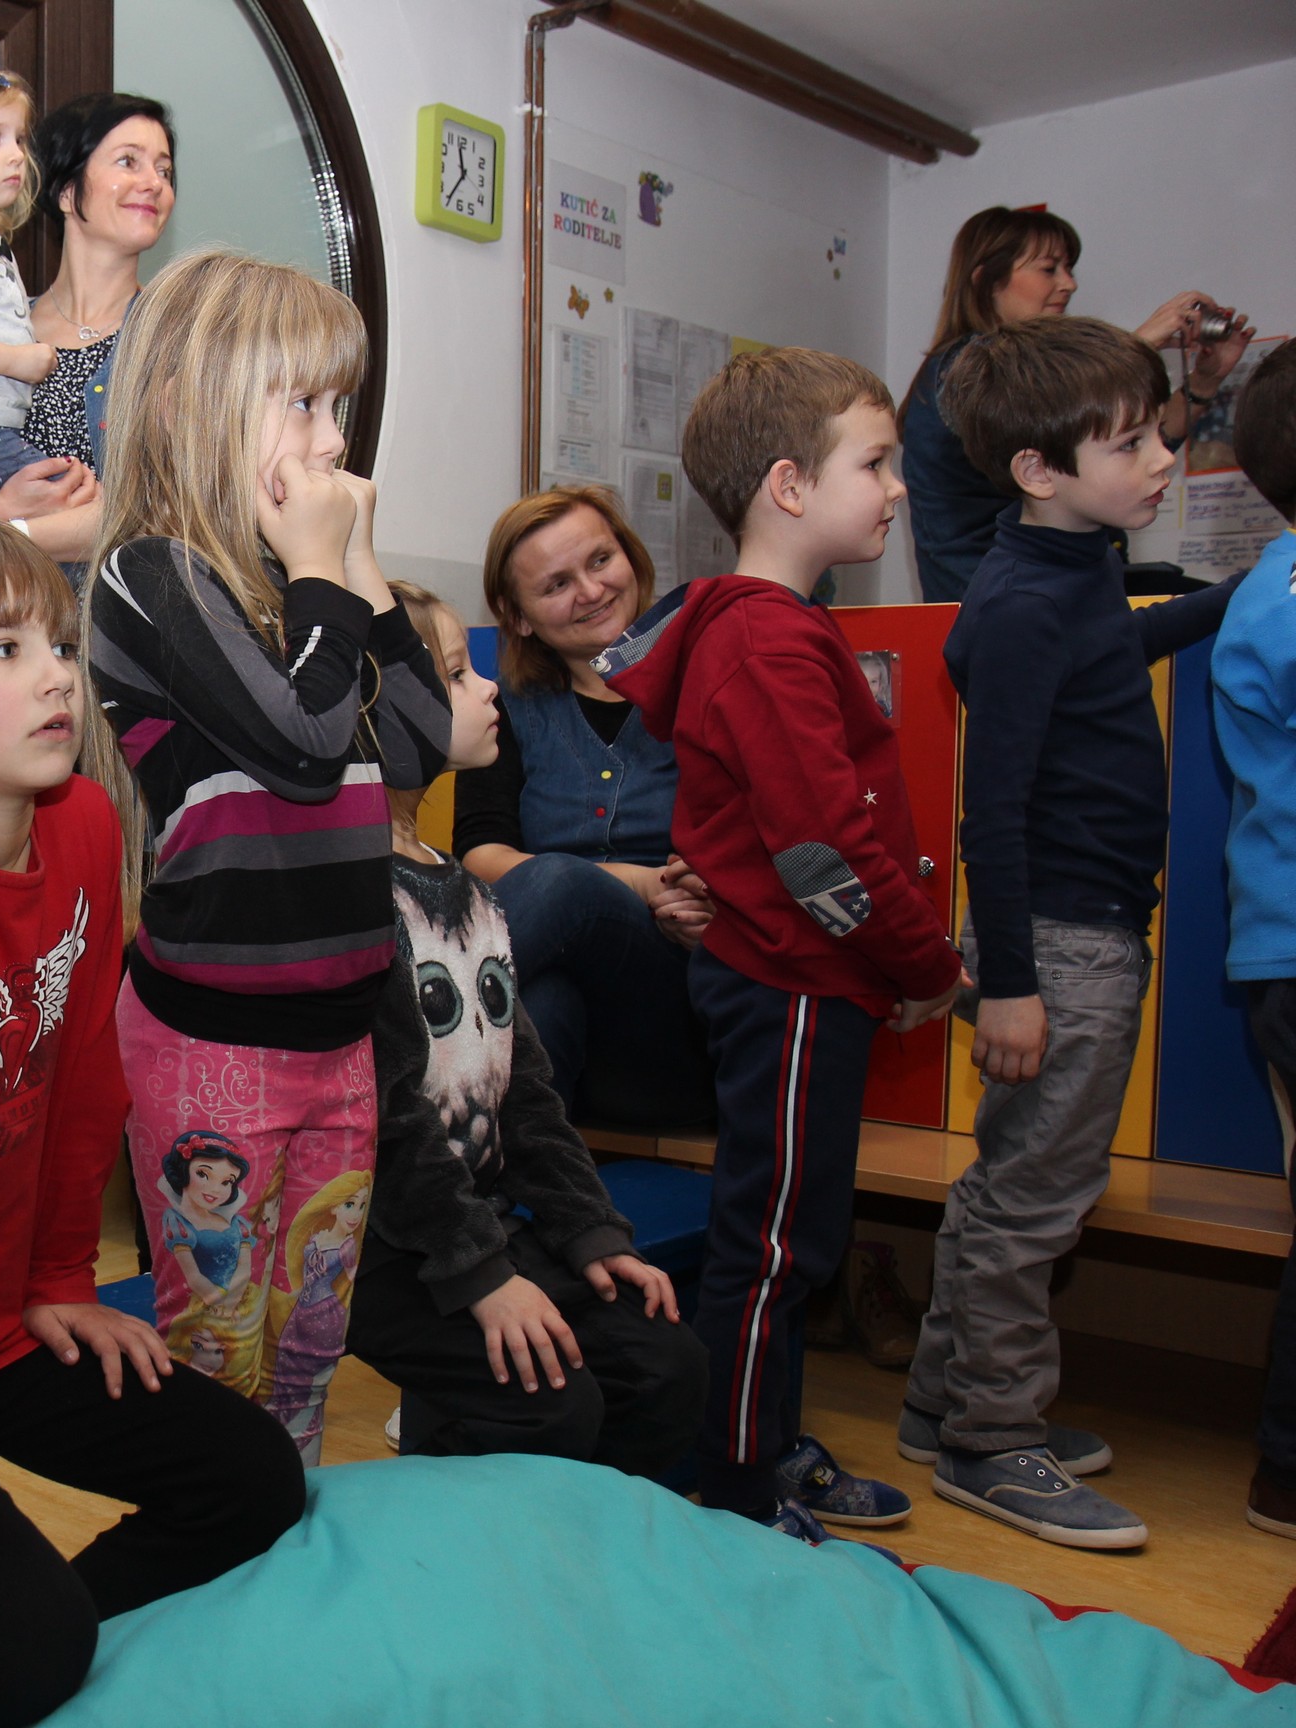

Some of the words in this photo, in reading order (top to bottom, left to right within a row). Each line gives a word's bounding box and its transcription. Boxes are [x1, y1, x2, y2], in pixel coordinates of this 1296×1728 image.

[477, 156, 486, 171] 2
[477, 174, 485, 188] 3
[455, 198, 464, 212] 6
[467, 202, 475, 217] 5
[560, 190, 599, 218] KUTIĆ
[601, 205, 617, 225] ZA
[553, 213, 622, 250] RODITELJE
